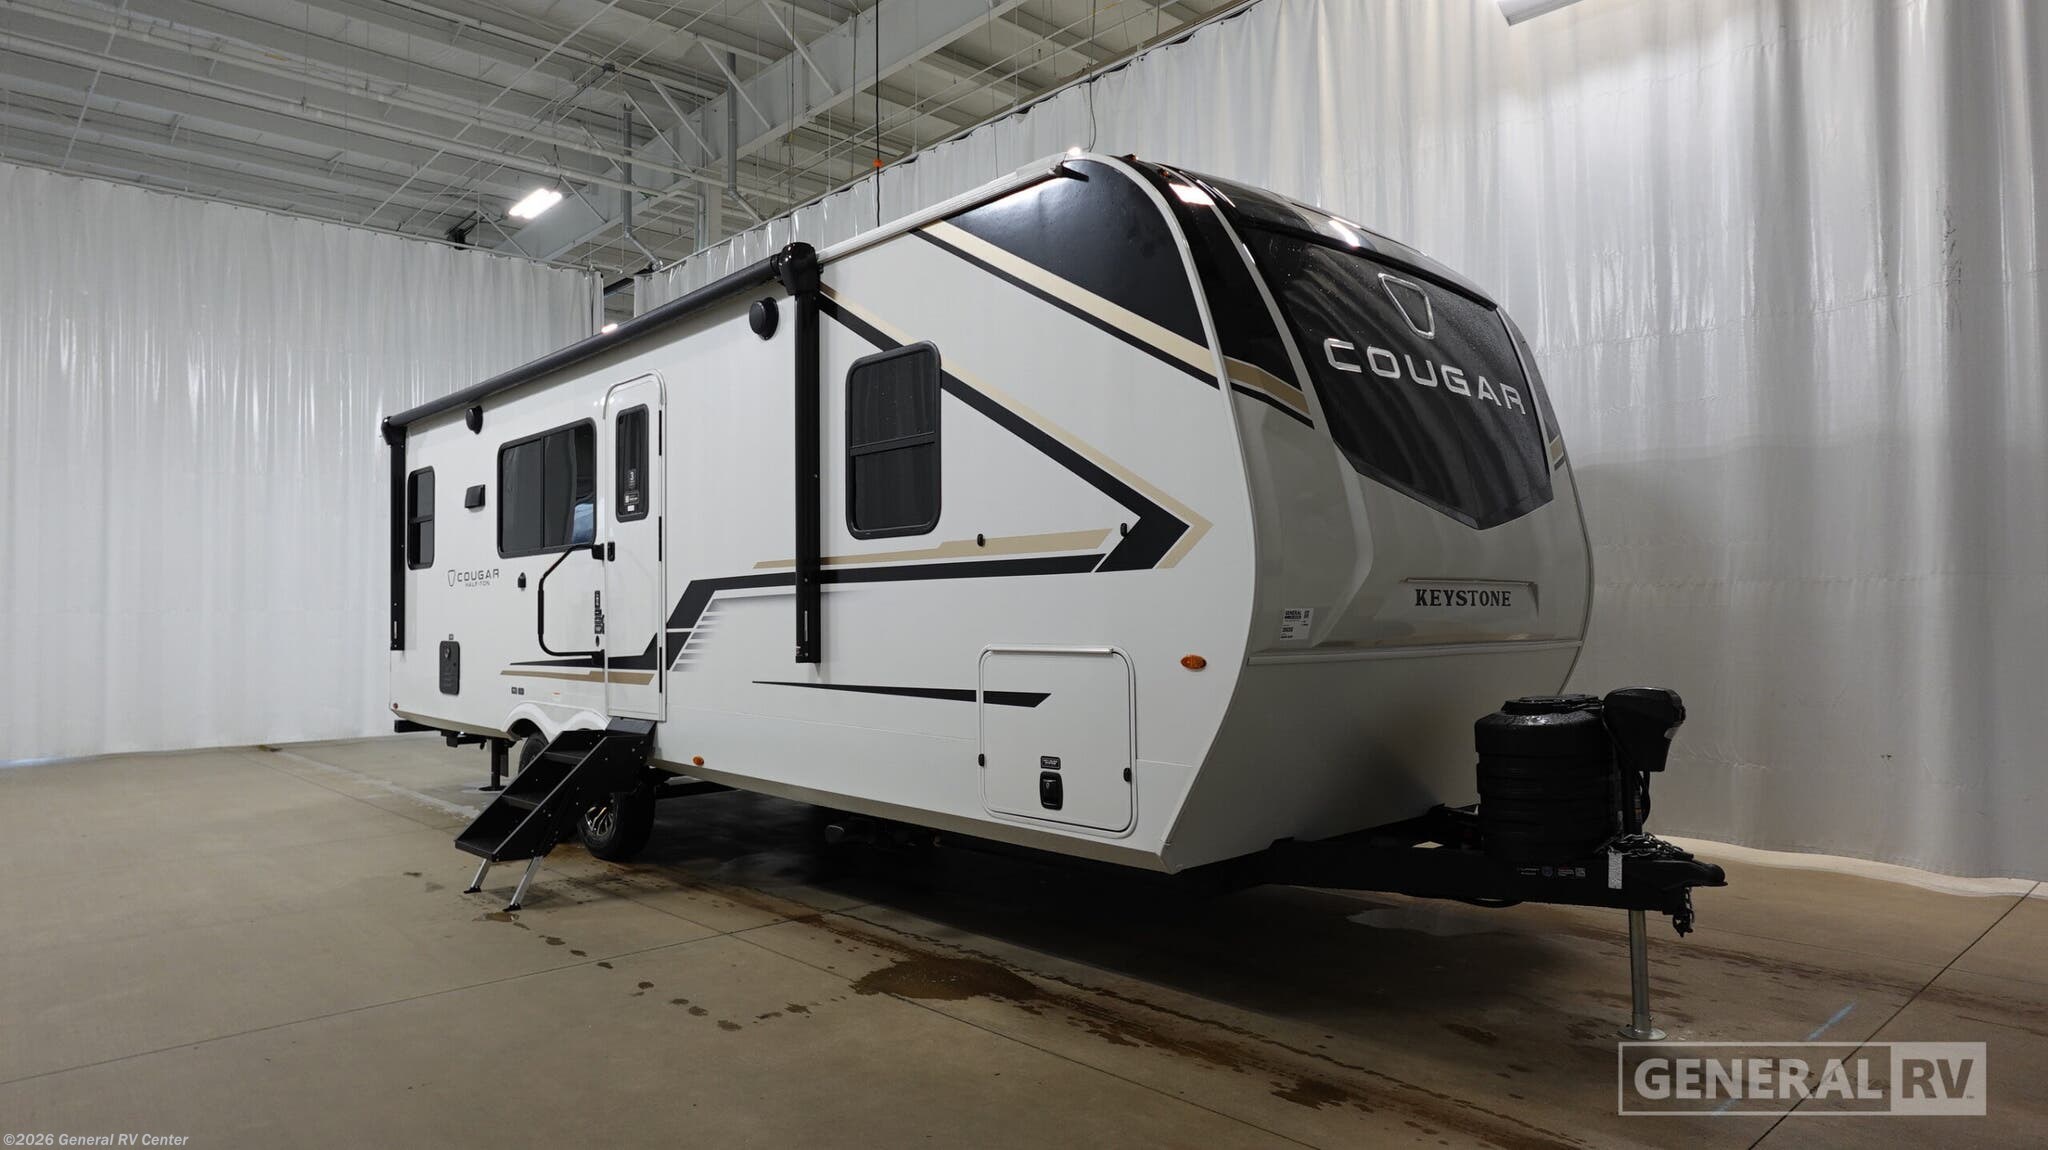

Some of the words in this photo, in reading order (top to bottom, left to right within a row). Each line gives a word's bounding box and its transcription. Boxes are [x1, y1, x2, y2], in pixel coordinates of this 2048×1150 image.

[1323, 337, 1526, 415] COUGAR
[457, 568, 500, 582] COUGAR
[1415, 589, 1512, 607] KEYSTONE
